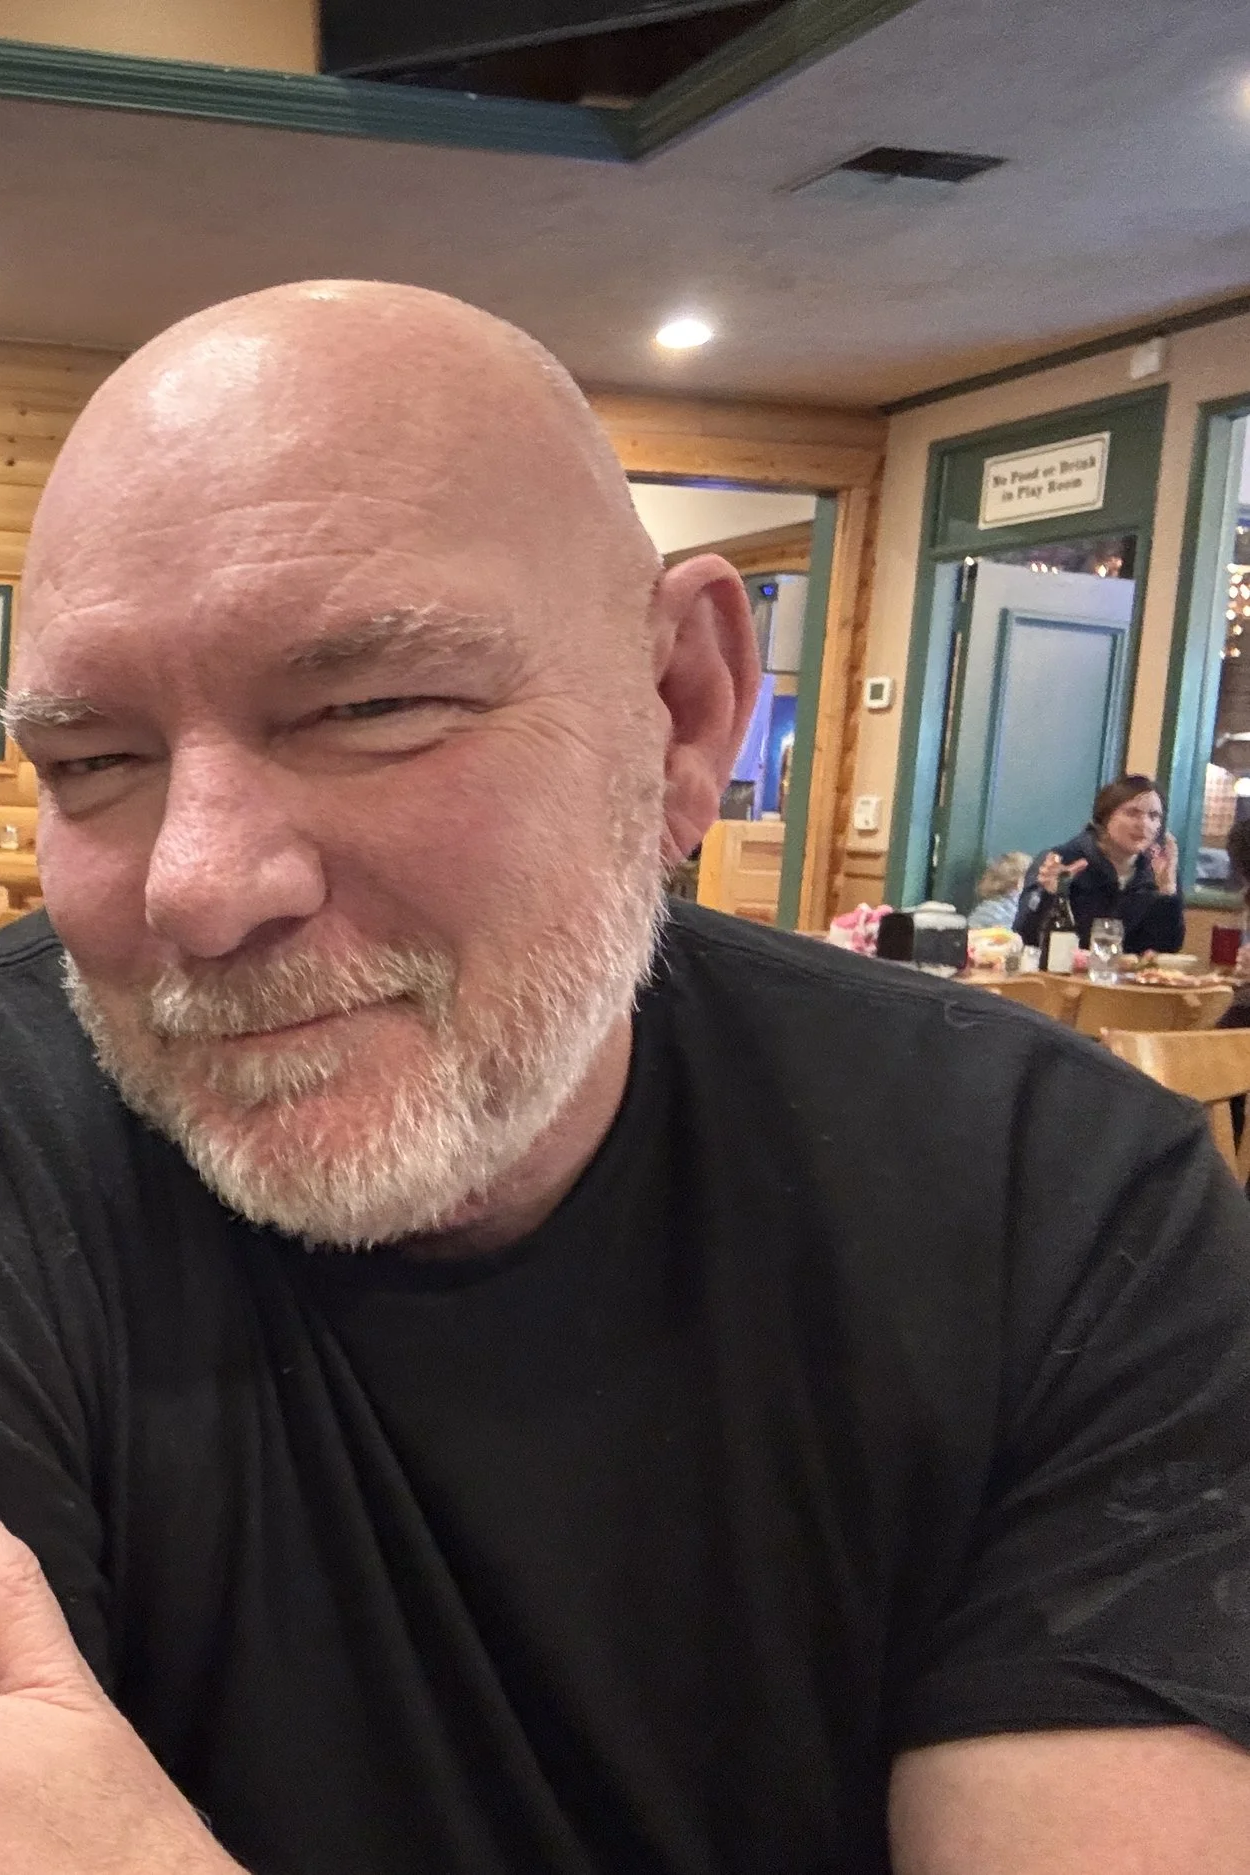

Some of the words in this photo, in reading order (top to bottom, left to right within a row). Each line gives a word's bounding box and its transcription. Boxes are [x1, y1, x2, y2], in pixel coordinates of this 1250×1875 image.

[993, 476, 1008, 488] No
[1011, 466, 1039, 484] Food
[1042, 466, 1055, 478] or
[1060, 455, 1096, 474] Drink
[1017, 486, 1043, 499] Play
[1048, 478, 1082, 493] Room
